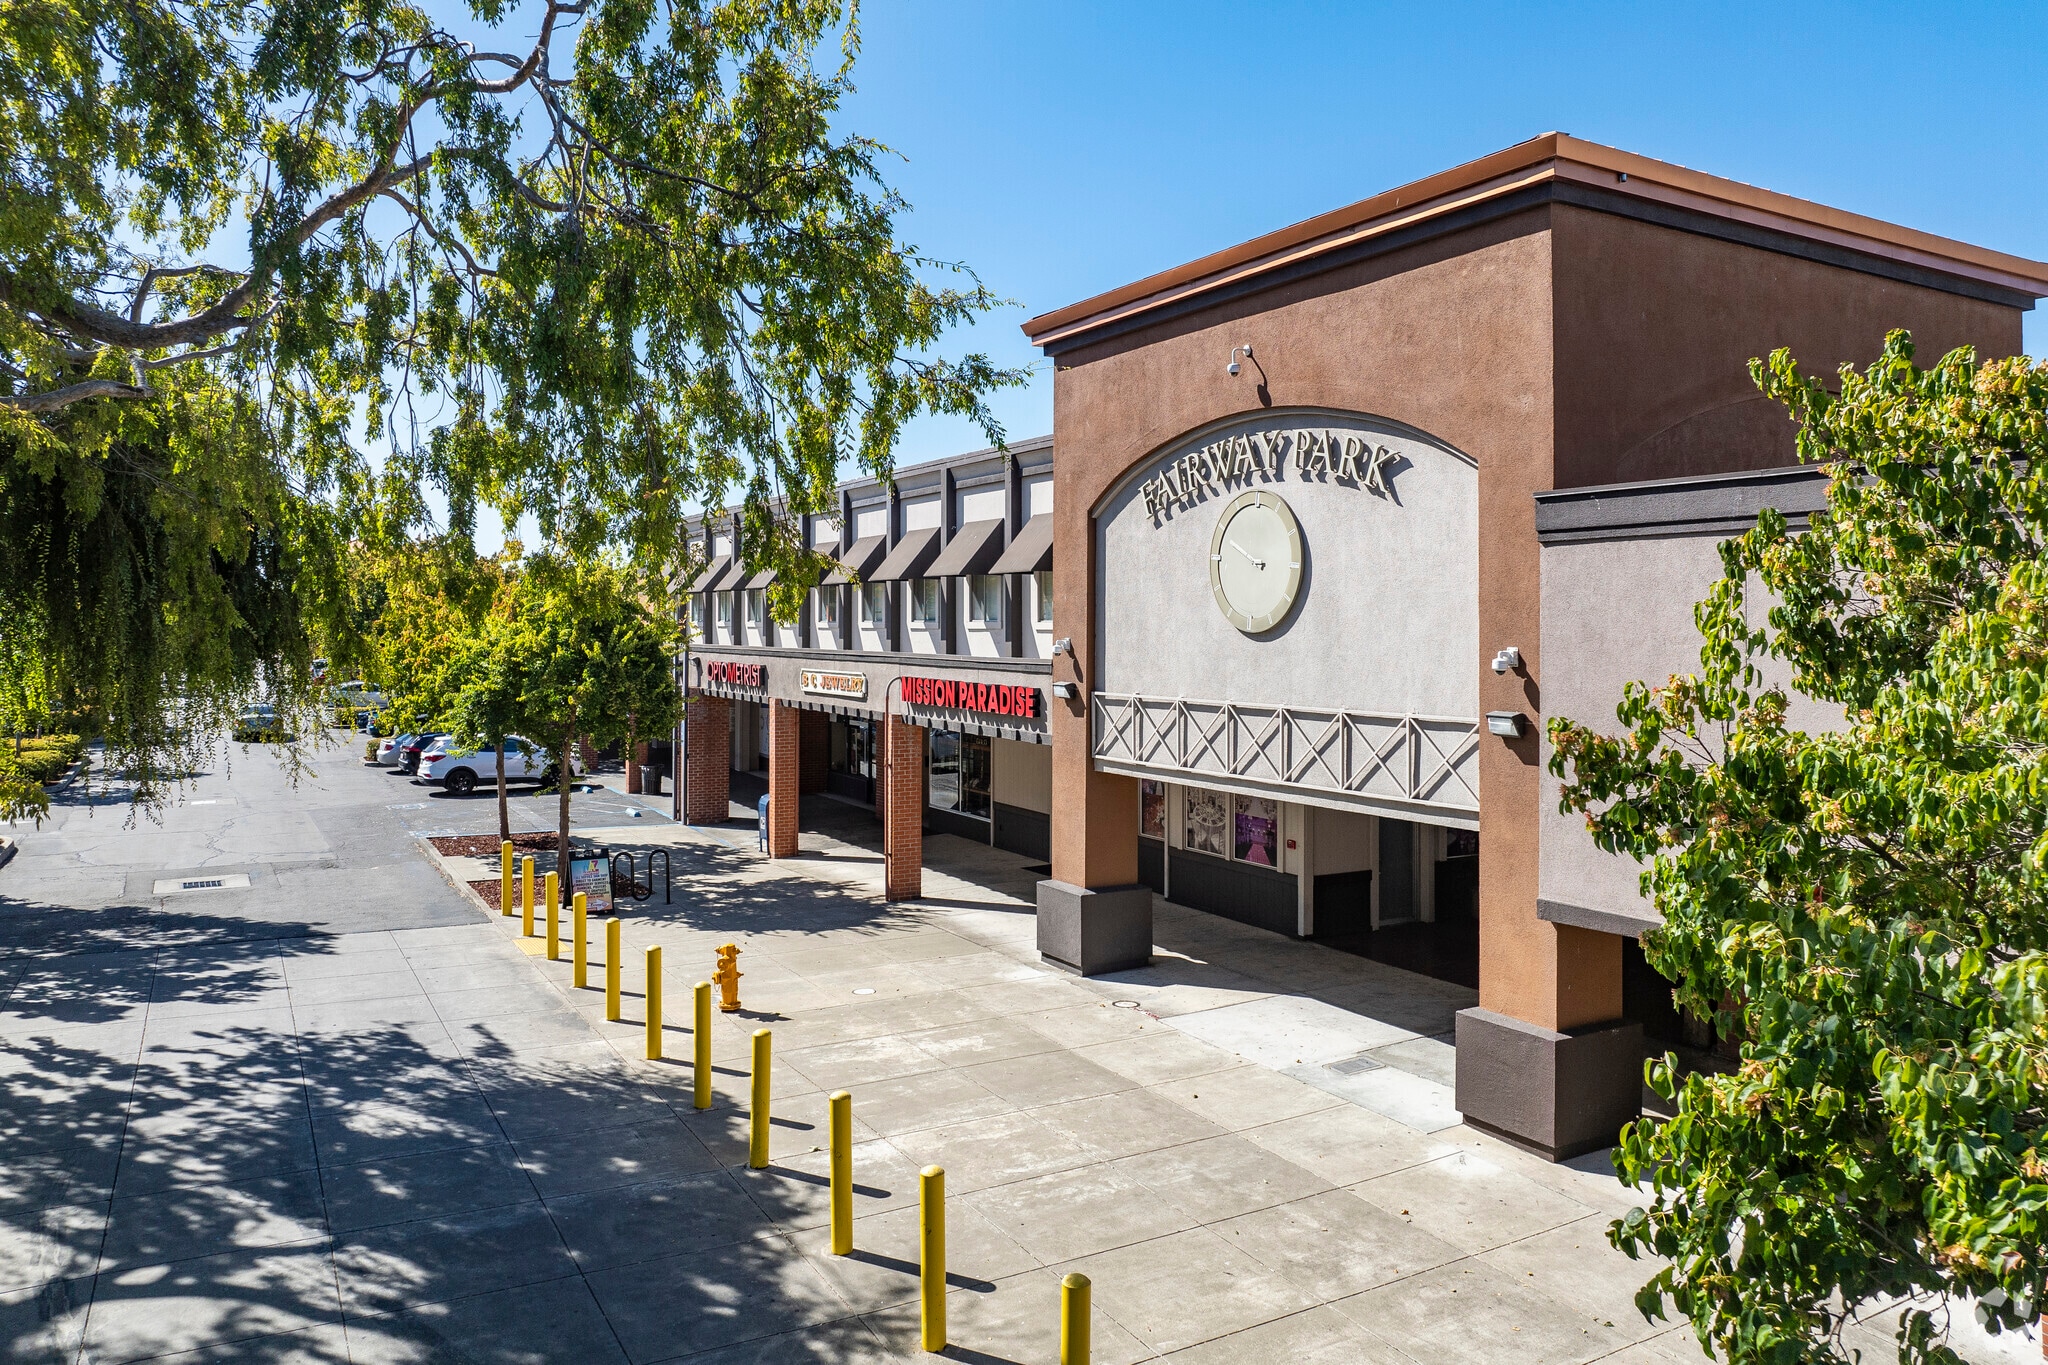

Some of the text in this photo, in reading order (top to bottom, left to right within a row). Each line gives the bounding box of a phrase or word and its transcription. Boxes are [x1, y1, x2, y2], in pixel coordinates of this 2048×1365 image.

[1138, 429, 1401, 520] FAIRWAY PARK
[707, 660, 761, 687] OPTOMETRIST
[820, 675, 864, 692] JEWELRY
[901, 676, 1035, 718] MISSION PARADISE
